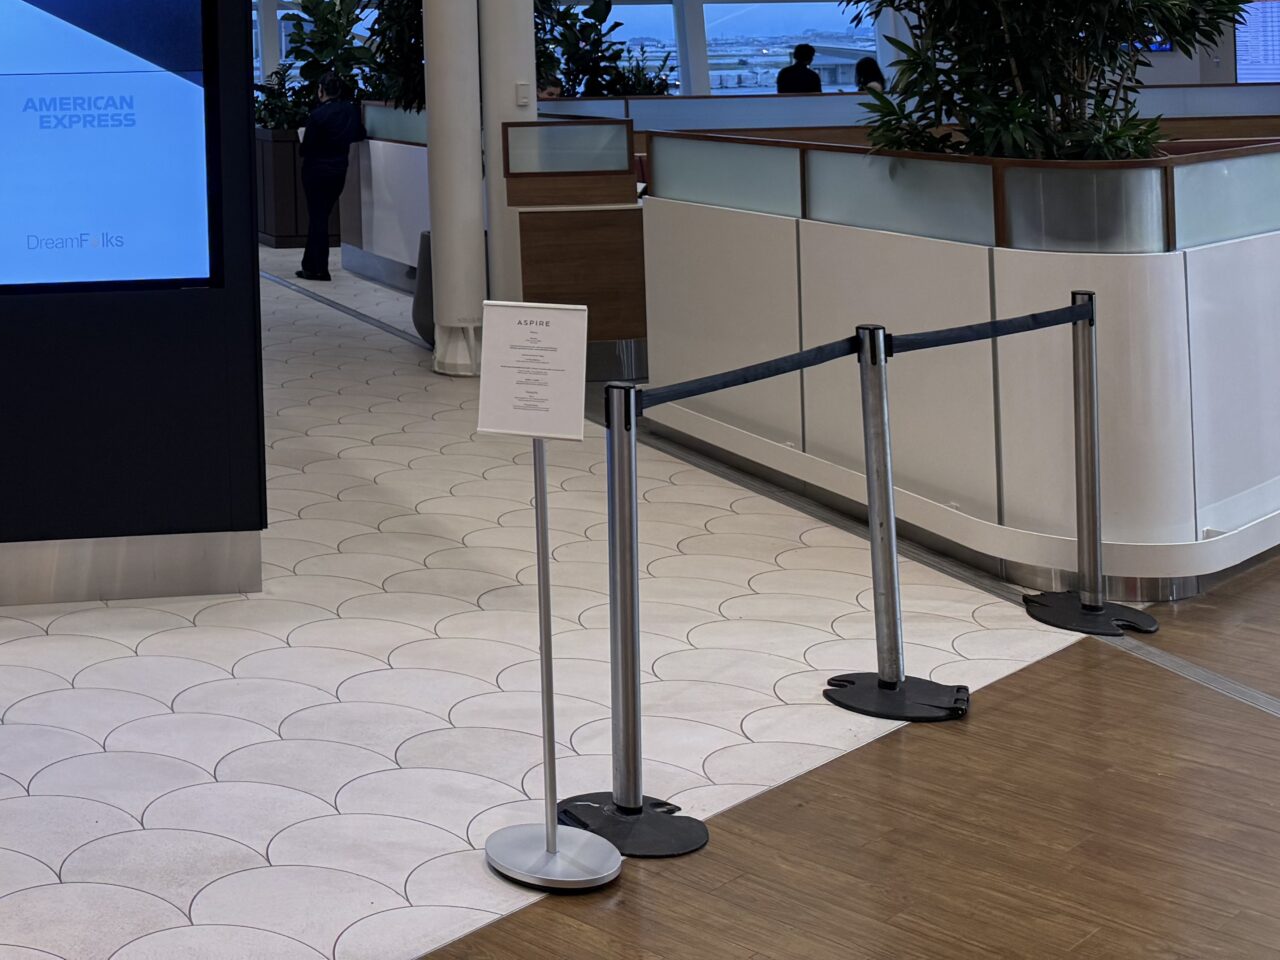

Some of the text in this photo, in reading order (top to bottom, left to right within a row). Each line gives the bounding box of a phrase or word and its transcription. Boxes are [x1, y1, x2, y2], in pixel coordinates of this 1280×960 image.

[22, 95, 134, 113] AMERICAN
[39, 113, 136, 130] EXPRESS
[517, 319, 551, 327] ASPIRE
